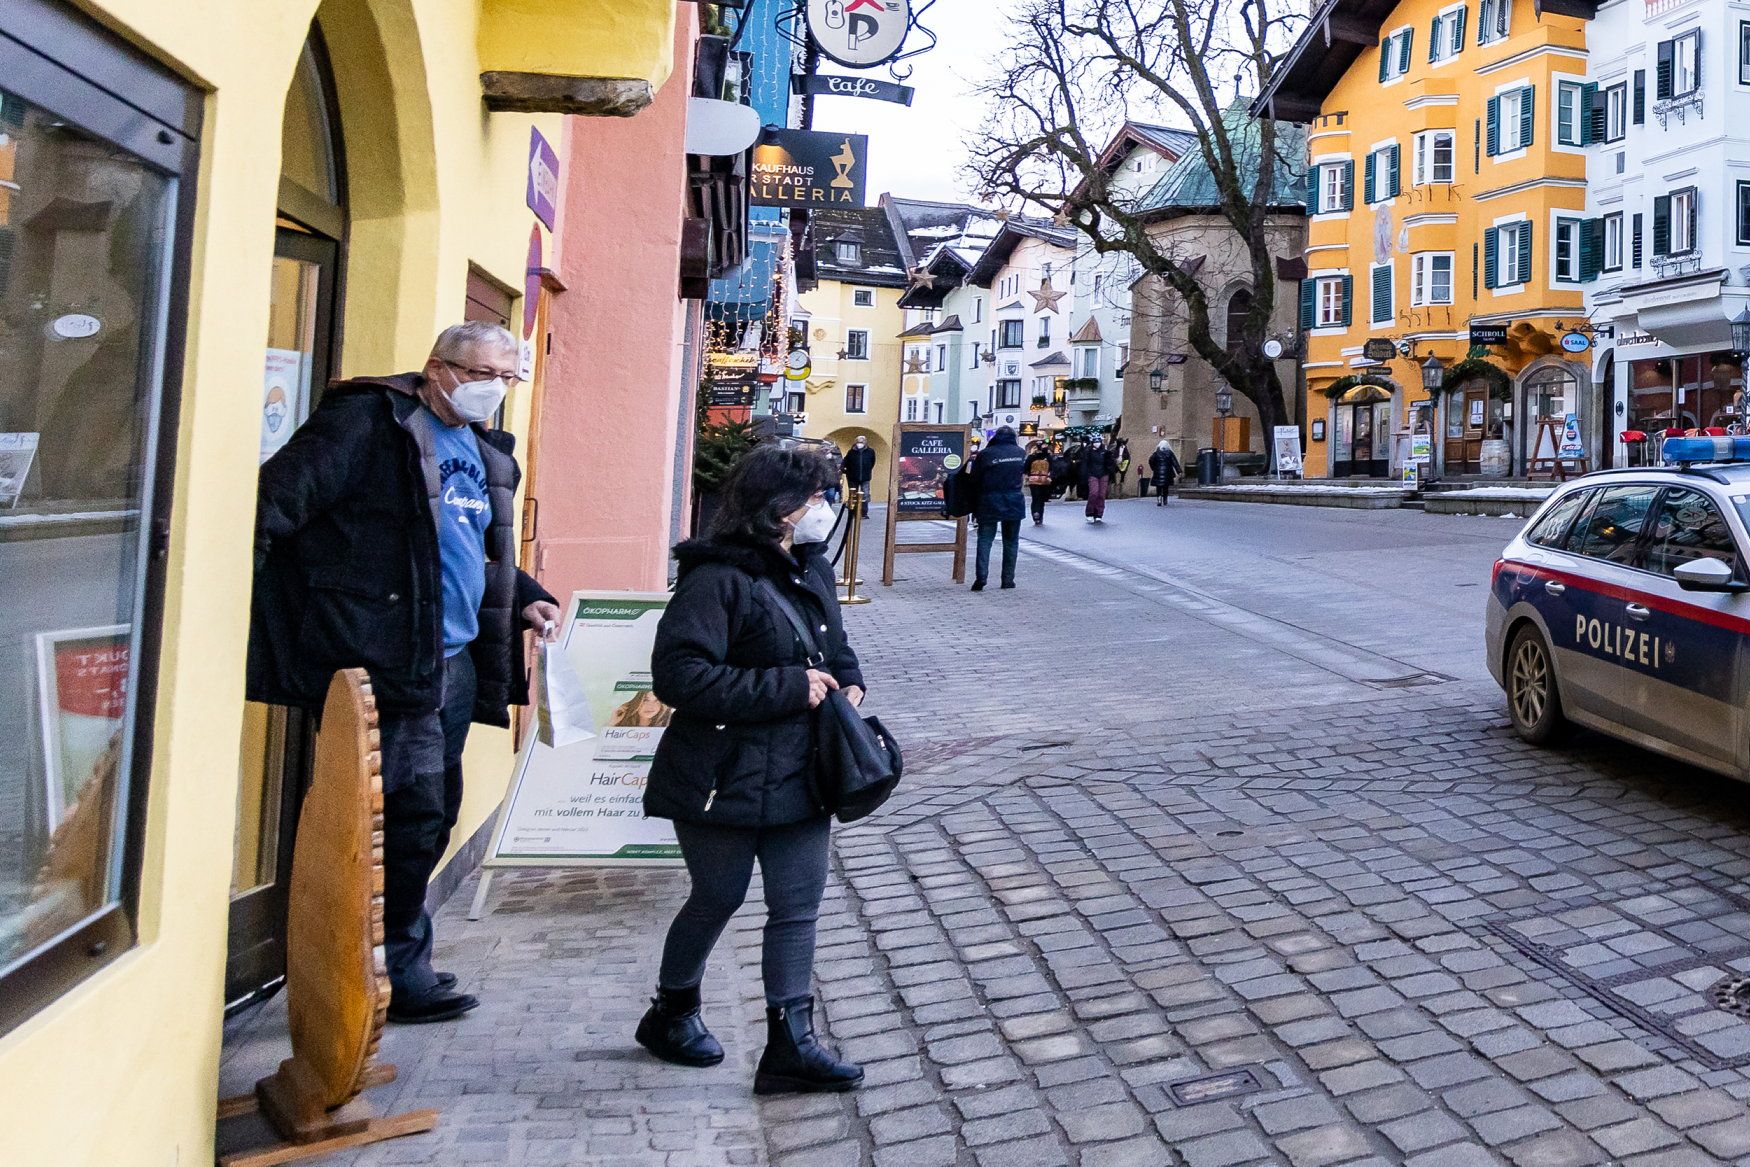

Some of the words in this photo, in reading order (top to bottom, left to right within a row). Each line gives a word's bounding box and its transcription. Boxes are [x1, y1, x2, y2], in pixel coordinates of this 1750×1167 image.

[827, 76, 880, 96] Cafe
[752, 163, 814, 175] KAUFHAUS
[763, 175, 813, 186] STADT
[750, 186, 854, 202] LLERIA
[921, 439, 943, 447] CAFE
[911, 446, 952, 454] GALLERIA
[583, 607, 631, 615] ÖKOPHARM
[1576, 613, 1659, 669] POLIZEI
[604, 729, 650, 741] HairCaps
[590, 772, 648, 789] HairCap
[570, 793, 592, 803] weil
[534, 808, 553, 817] mit
[556, 807, 594, 817] vollem
[597, 807, 625, 817] Haar
